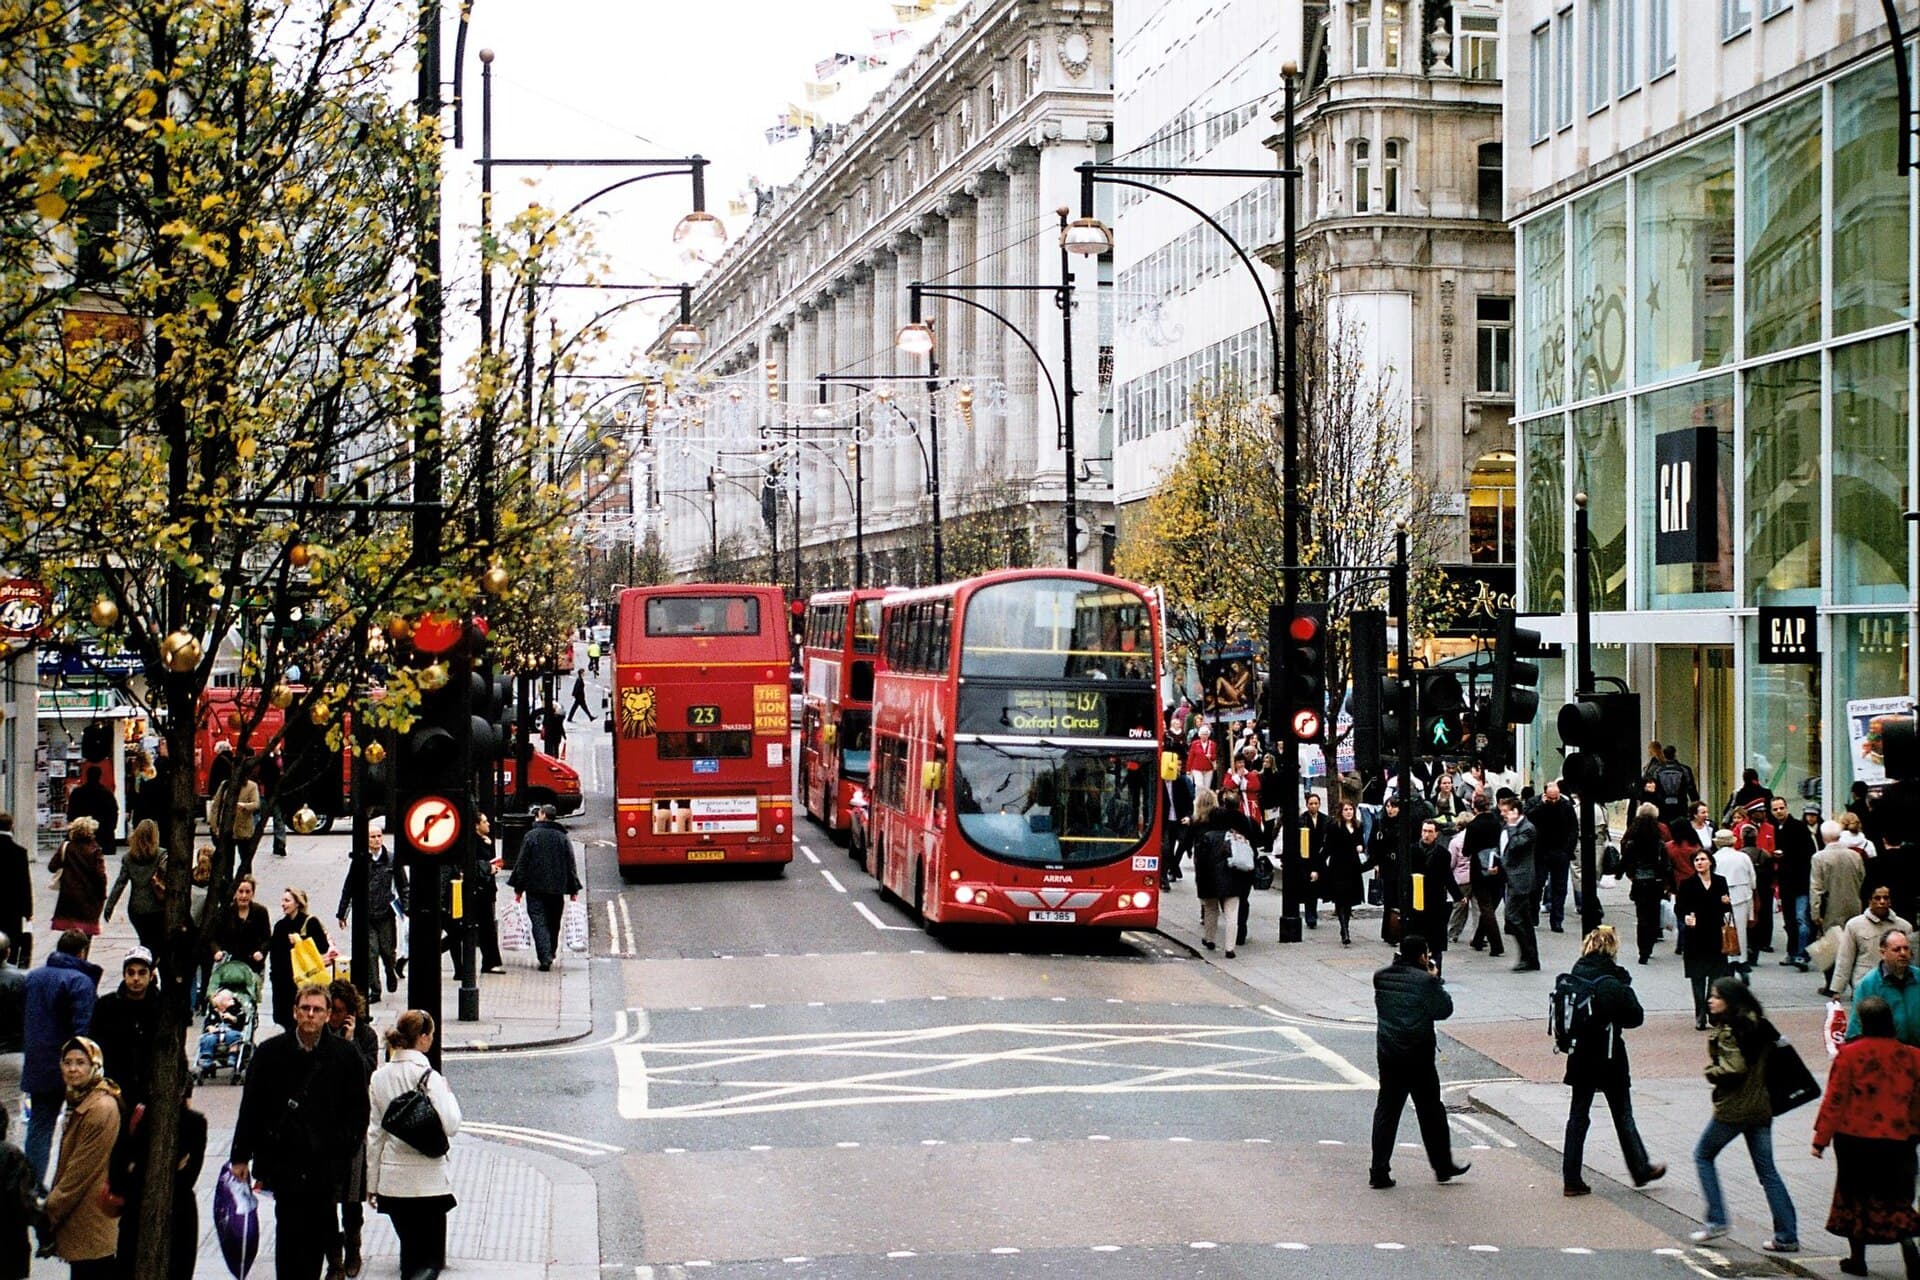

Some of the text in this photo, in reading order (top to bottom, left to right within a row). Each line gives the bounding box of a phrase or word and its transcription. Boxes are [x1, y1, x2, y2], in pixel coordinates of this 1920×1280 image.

[1660, 461, 1692, 533] GAP
[1771, 617, 1806, 645] GAP
[758, 689, 781, 700] THE
[755, 702, 786, 714] LION
[1077, 692, 1099, 712] 137
[694, 708, 715, 724] 23
[755, 716, 787, 727] KING
[1013, 715, 1099, 729] Oxford Circus
[1043, 875, 1073, 883] ARRIVA
[1034, 911, 1070, 921] WLT 385
